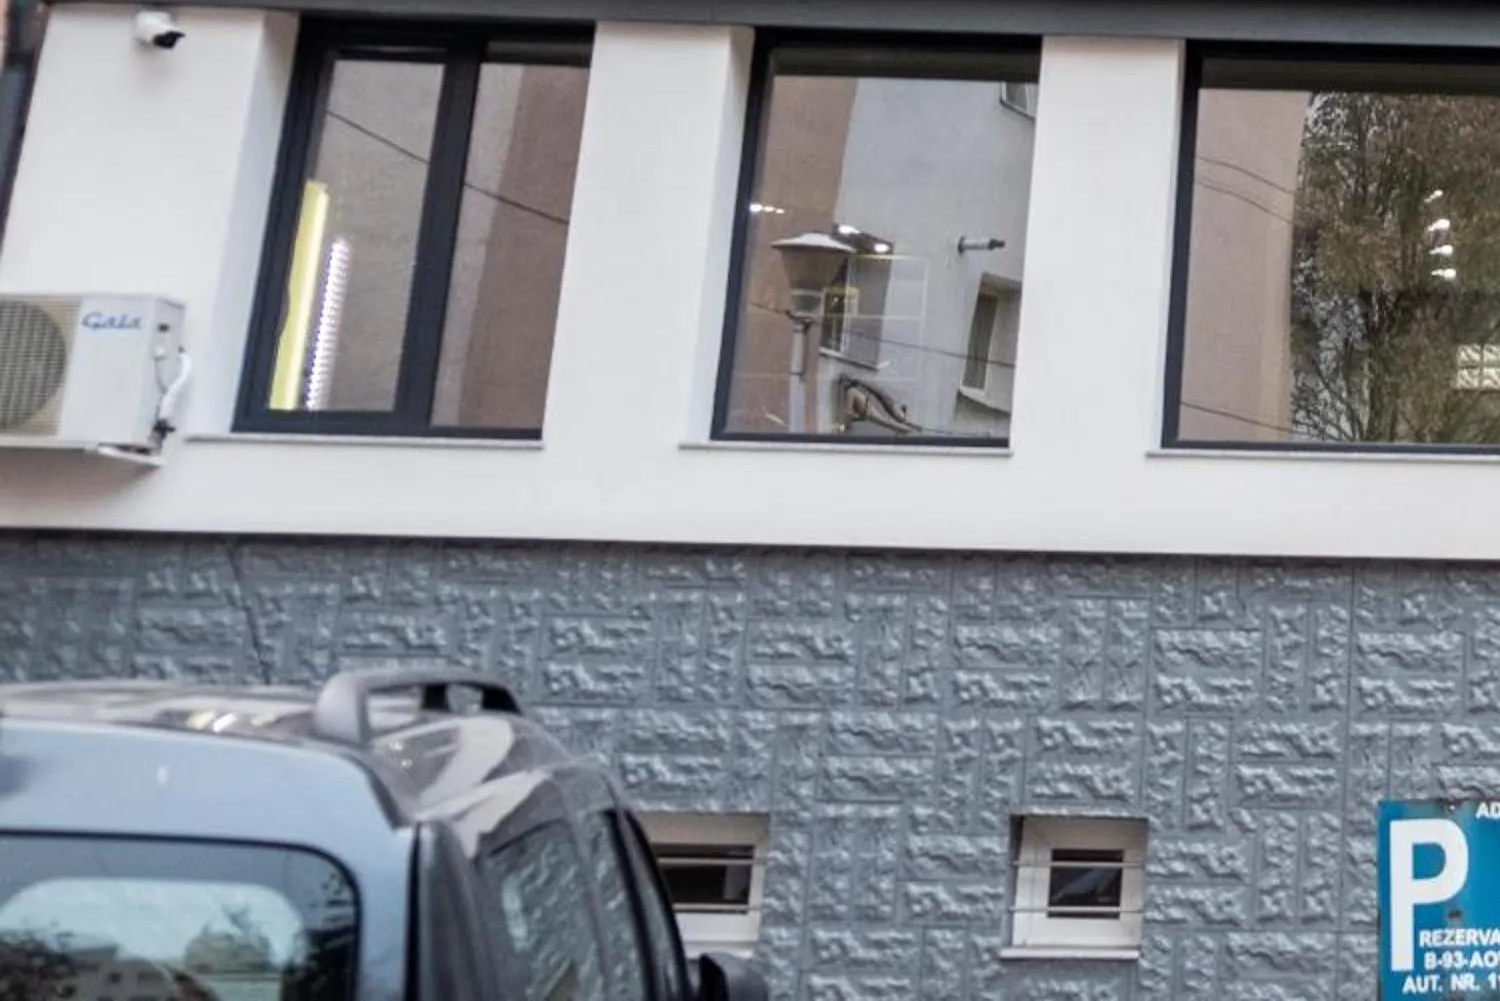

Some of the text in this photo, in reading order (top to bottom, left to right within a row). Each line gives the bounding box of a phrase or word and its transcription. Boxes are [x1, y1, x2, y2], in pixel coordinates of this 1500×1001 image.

[1389, 818, 1469, 972] P
[1402, 974, 1443, 994] AUT.
[1451, 972, 1480, 991] NR.
